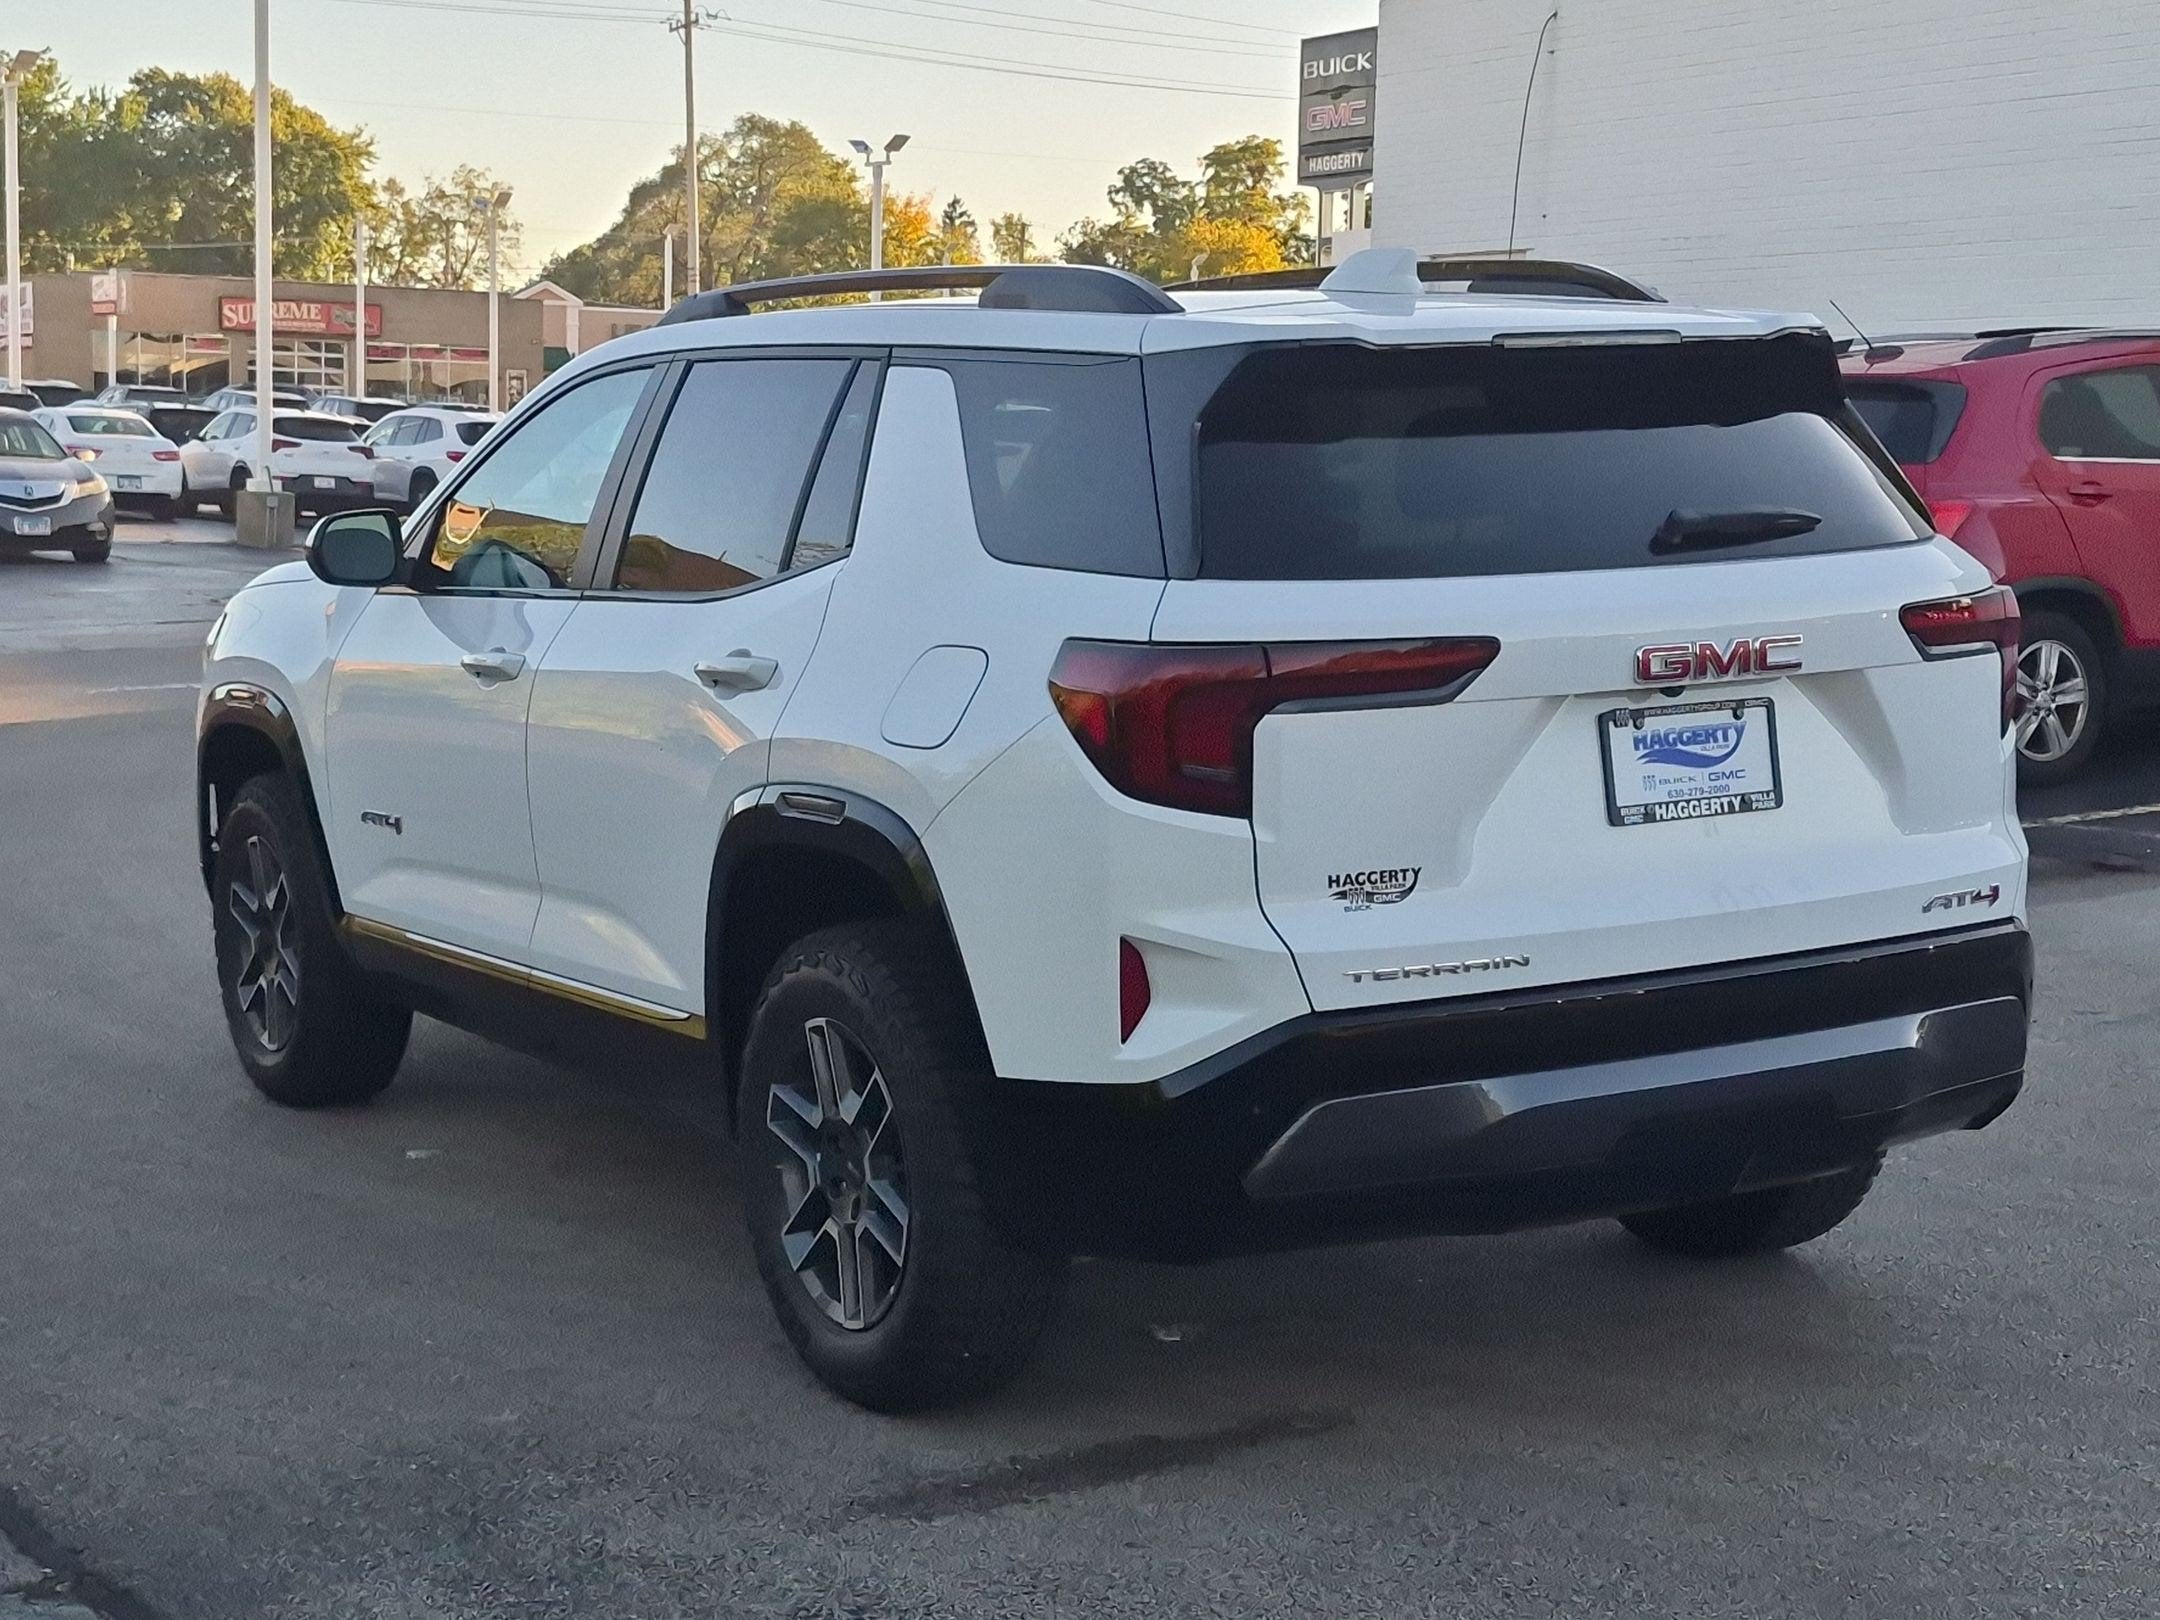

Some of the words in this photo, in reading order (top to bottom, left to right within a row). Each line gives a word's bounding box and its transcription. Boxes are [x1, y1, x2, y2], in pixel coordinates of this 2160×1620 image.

[1303, 51, 1373, 79] BUICK
[1306, 100, 1367, 131] GMC
[1309, 152, 1364, 172] HAGGERTY
[223, 301, 322, 327] SUREME
[1634, 634, 1803, 684] GMC
[1632, 721, 1747, 752] HAGGERTY
[1658, 776, 1697, 785] BUICK
[1708, 769, 1746, 782] GMC
[1655, 795, 1742, 820] HAGGERTY
[1750, 792, 1775, 802] VILLA
[1752, 801, 1776, 809] PARK
[1620, 806, 1645, 816] BUICK
[1327, 866, 1422, 889] HAGGERTY
[1344, 904, 1372, 912] BUICK
[1373, 893, 1400, 902] GMC
[1922, 882, 2000, 914] AT4
[1343, 953, 1531, 983] TERRAIN
